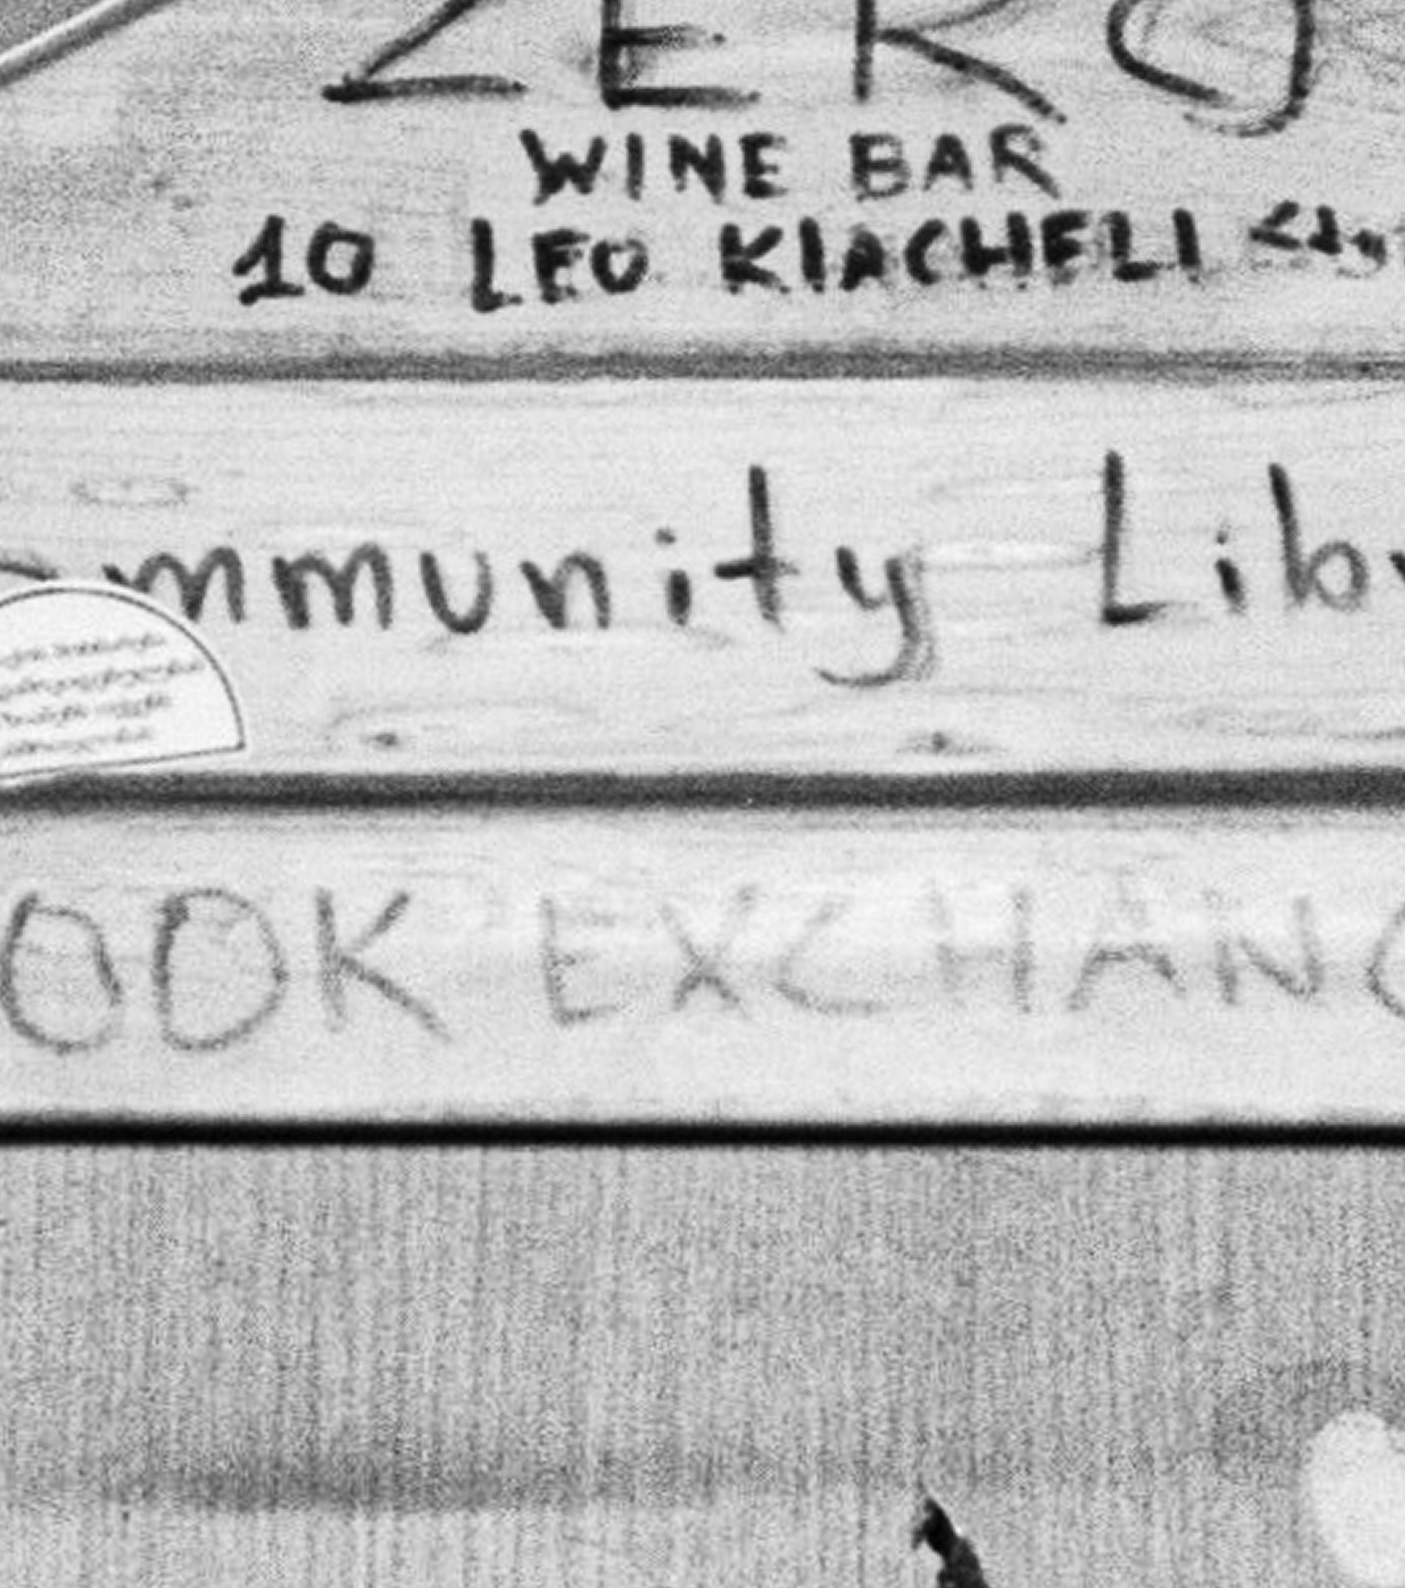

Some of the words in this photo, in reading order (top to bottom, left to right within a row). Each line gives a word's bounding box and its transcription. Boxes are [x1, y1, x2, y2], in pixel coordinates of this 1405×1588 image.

[518, 127, 786, 206] WINE
[848, 124, 1062, 202] BAR
[232, 214, 376, 308] 10
[470, 216, 651, 314] LEO
[718, 208, 1204, 296] KIACHELI
